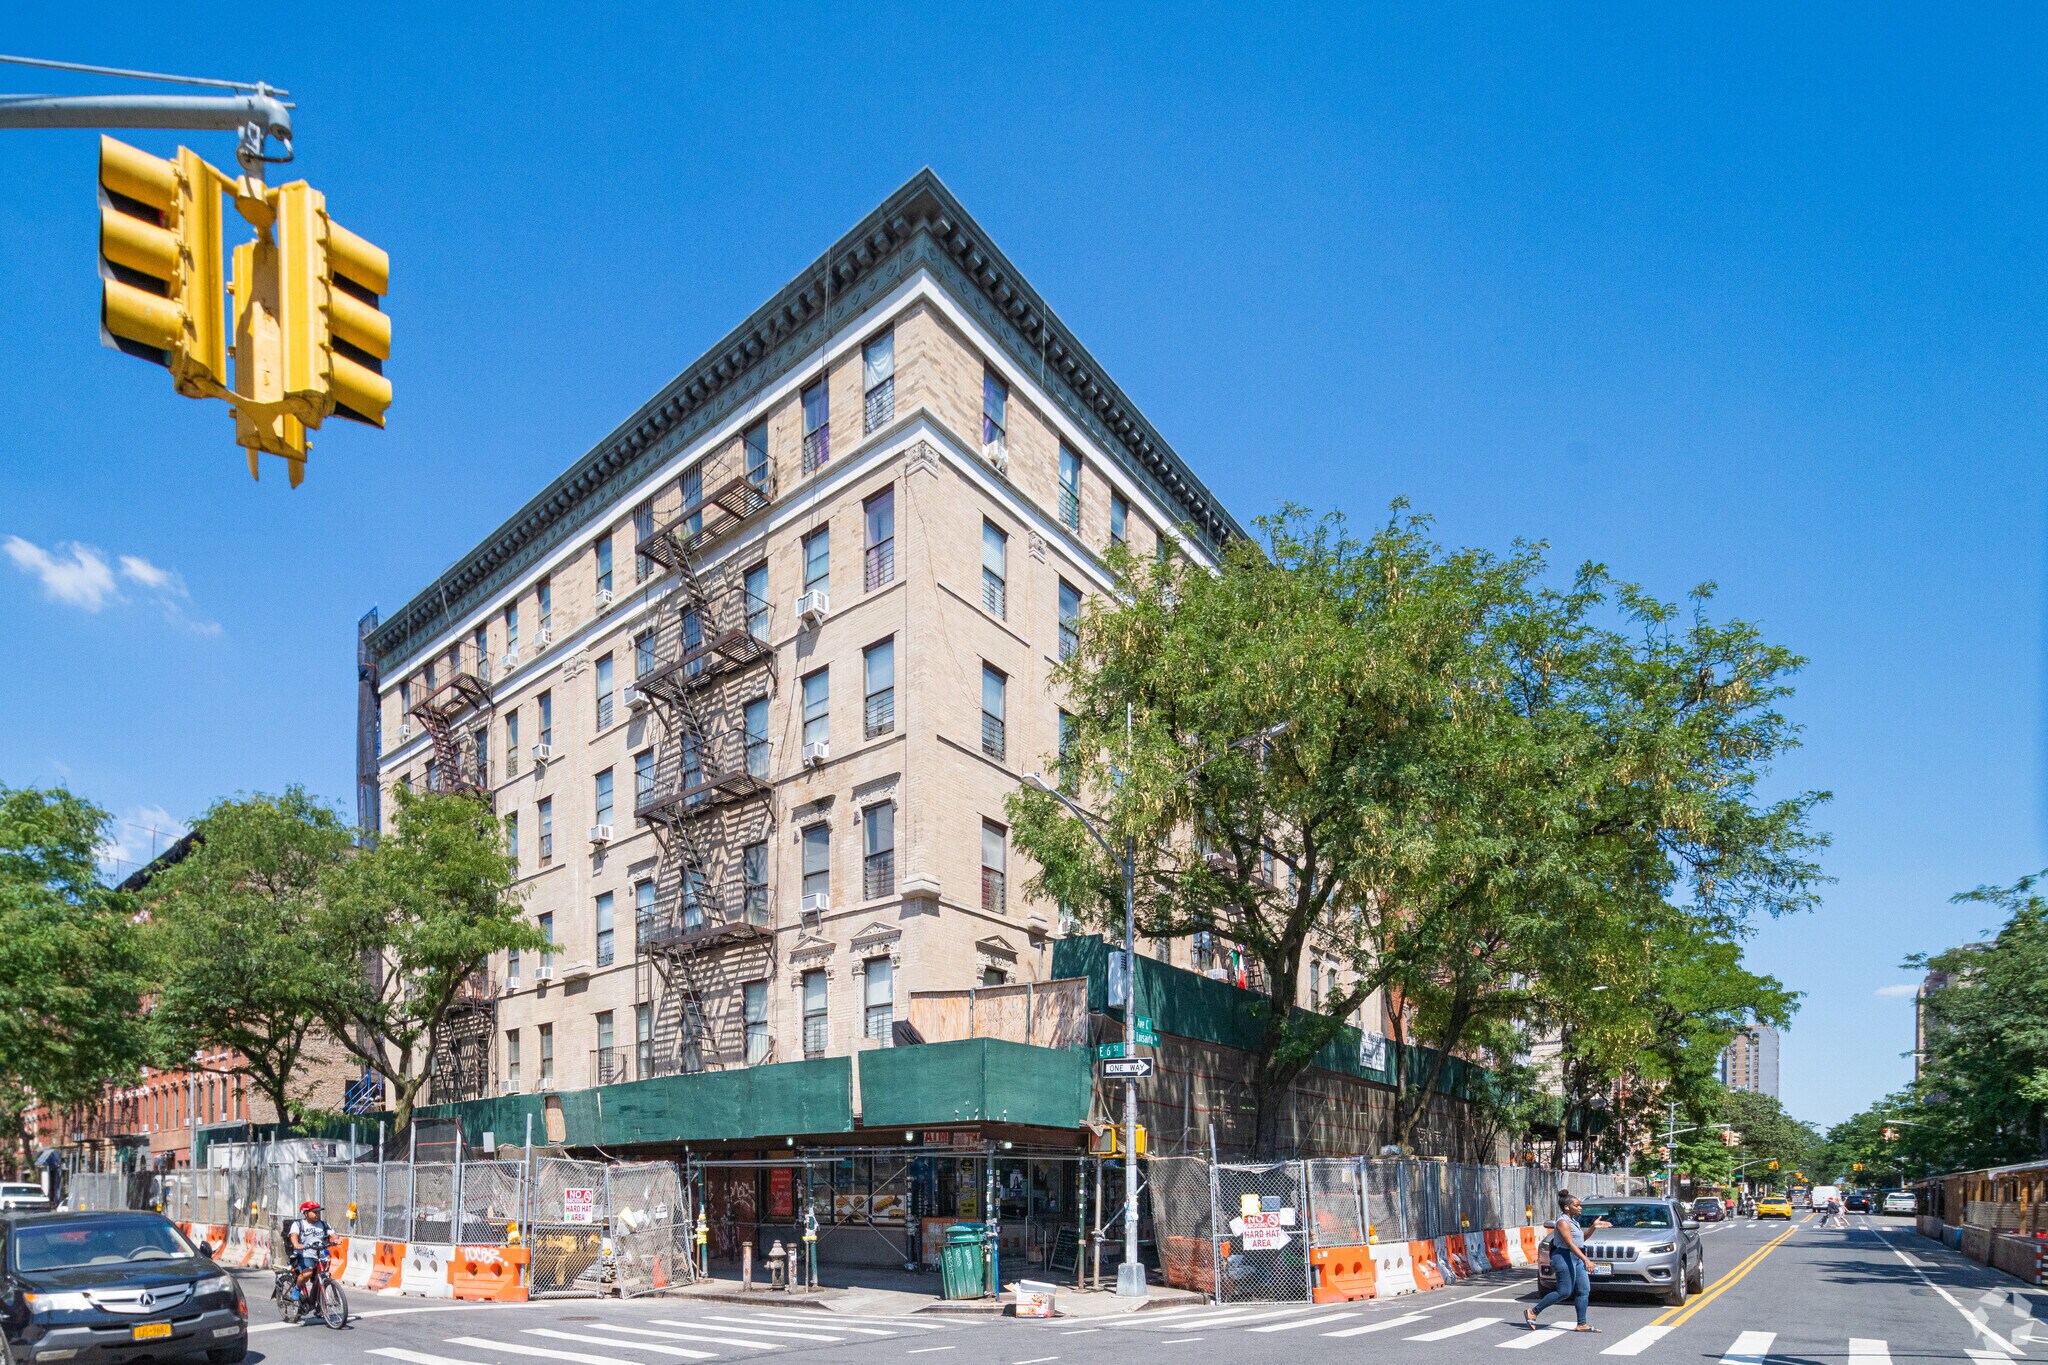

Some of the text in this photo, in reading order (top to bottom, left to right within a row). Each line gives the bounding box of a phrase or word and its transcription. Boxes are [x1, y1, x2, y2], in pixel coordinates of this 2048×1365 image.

[1136, 1018, 1150, 1030] Ave C
[1099, 1046, 1104, 1057] E
[1106, 1046, 1110, 1056] 6
[1129, 1064, 1145, 1072] WAY
[925, 1132, 948, 1141] ATM
[570, 1190, 582, 1199] NO
[1248, 1214, 1264, 1224] NO
[1244, 1229, 1280, 1239] HARD HAT
[1252, 1240, 1272, 1248] AREA
